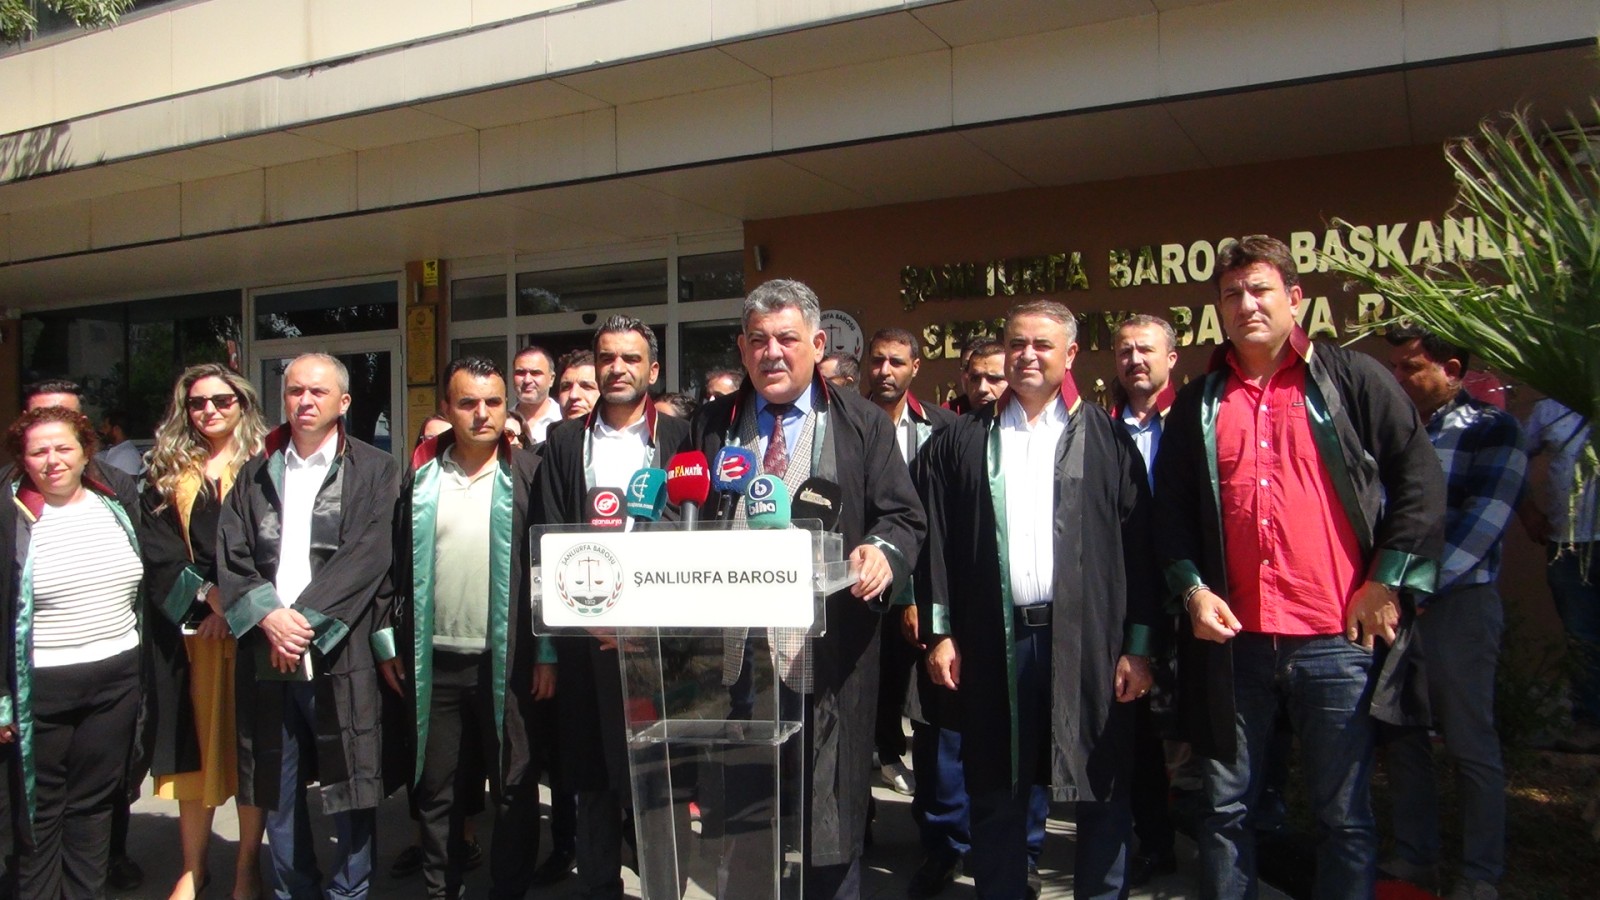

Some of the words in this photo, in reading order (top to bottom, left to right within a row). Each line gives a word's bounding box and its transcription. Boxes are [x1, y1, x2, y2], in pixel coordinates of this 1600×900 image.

[1109, 234, 1268, 288] BARO
[593, 545, 616, 565] BAROSU
[633, 571, 723, 587] ŞANLIURFA
[727, 570, 797, 584] BAROSU
